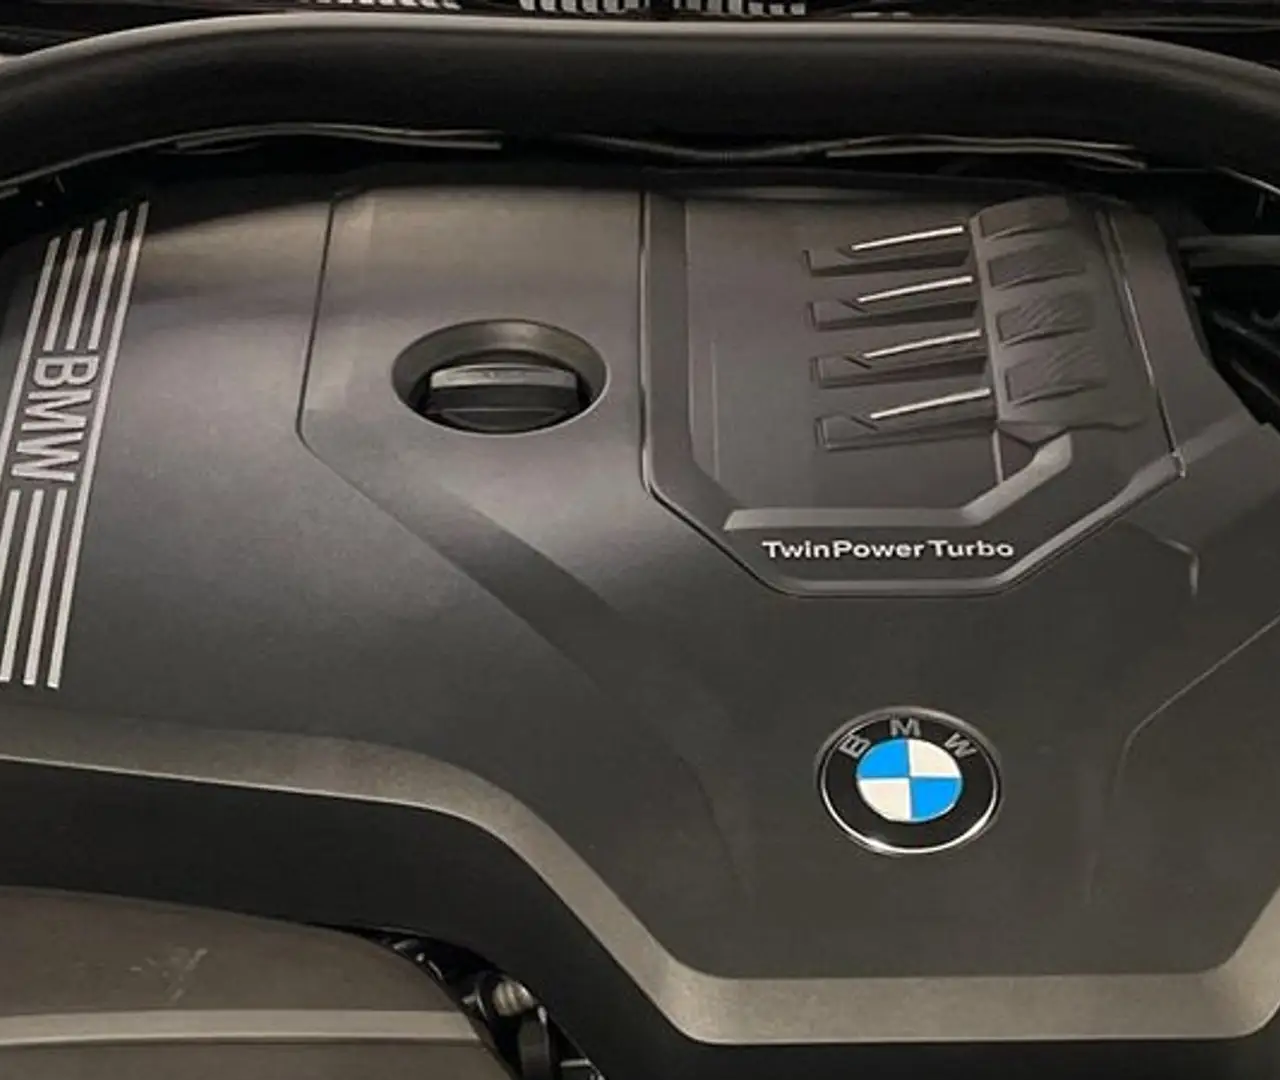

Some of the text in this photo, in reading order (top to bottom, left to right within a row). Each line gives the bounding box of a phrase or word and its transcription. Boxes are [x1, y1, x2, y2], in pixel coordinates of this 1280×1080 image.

[11, 356, 99, 482] BMW
[762, 540, 1014, 559] TwinPower Turbo
[840, 717, 977, 759] BMW
